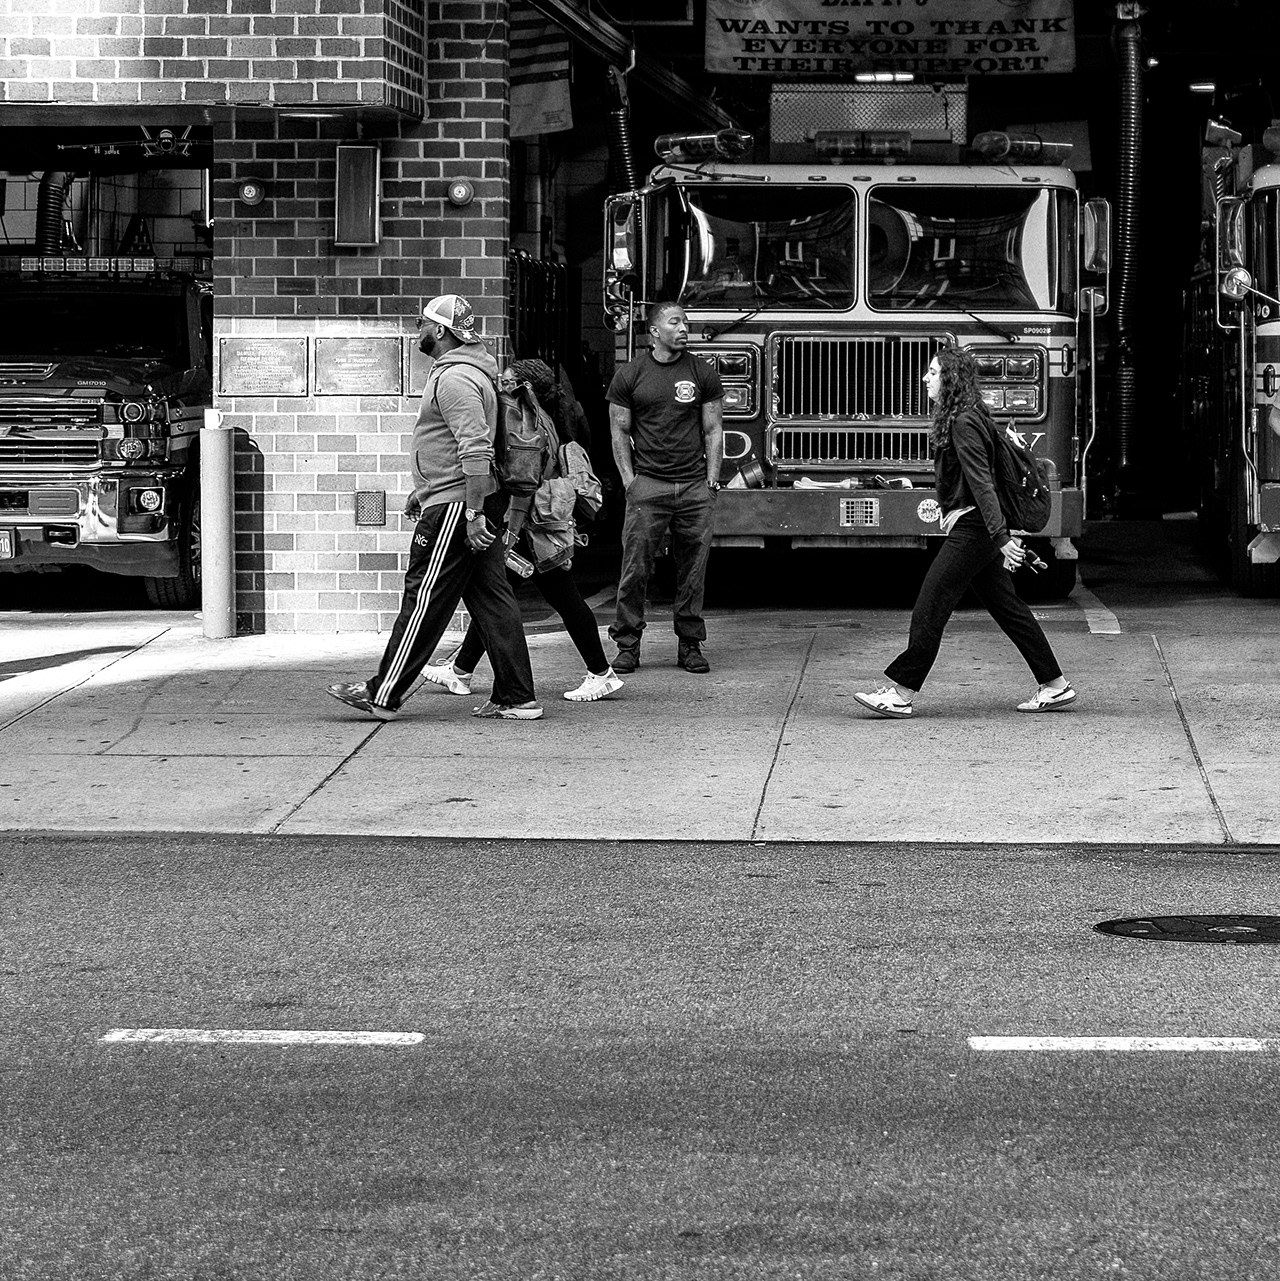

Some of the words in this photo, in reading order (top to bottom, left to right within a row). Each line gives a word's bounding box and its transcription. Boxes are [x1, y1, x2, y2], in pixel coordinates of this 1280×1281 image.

[716, 20, 851, 35] WANTS
[867, 21, 915, 35] TO
[930, 19, 1068, 35] THANK
[742, 39, 947, 53] EVERYONE
[963, 38, 1041, 53] FOR
[733, 58, 853, 72] THEIR
[877, 57, 1050, 72] SUPPORT
